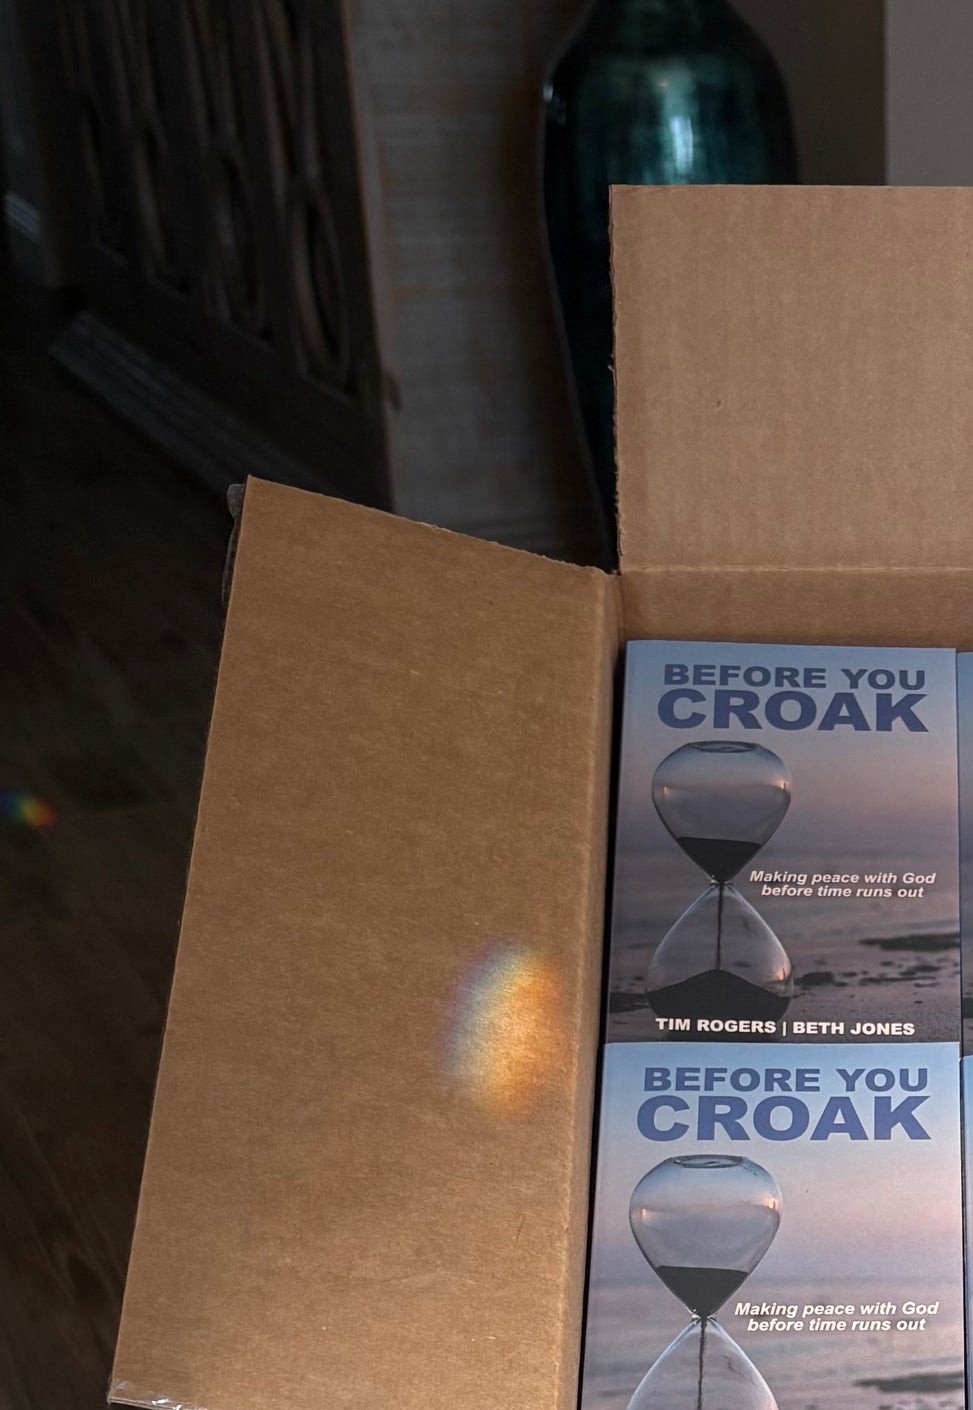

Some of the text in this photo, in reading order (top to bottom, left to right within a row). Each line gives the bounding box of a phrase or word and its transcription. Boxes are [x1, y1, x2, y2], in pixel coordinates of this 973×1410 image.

[664, 664, 925, 690] BEFORE YOU
[657, 688, 929, 732] CROAK
[750, 871, 936, 885] Making peace with God
[762, 884, 924, 898] before time runs out
[656, 1018, 690, 1031] TIM
[697, 1019, 777, 1033] ROGERS
[793, 1022, 844, 1034] BETH
[850, 1023, 915, 1035] JONES
[644, 1067, 928, 1092] BEFORE YOU
[637, 1095, 931, 1141] CROAK
[735, 1302, 939, 1317] Making peace with God
[748, 1317, 925, 1331] before time runs out
